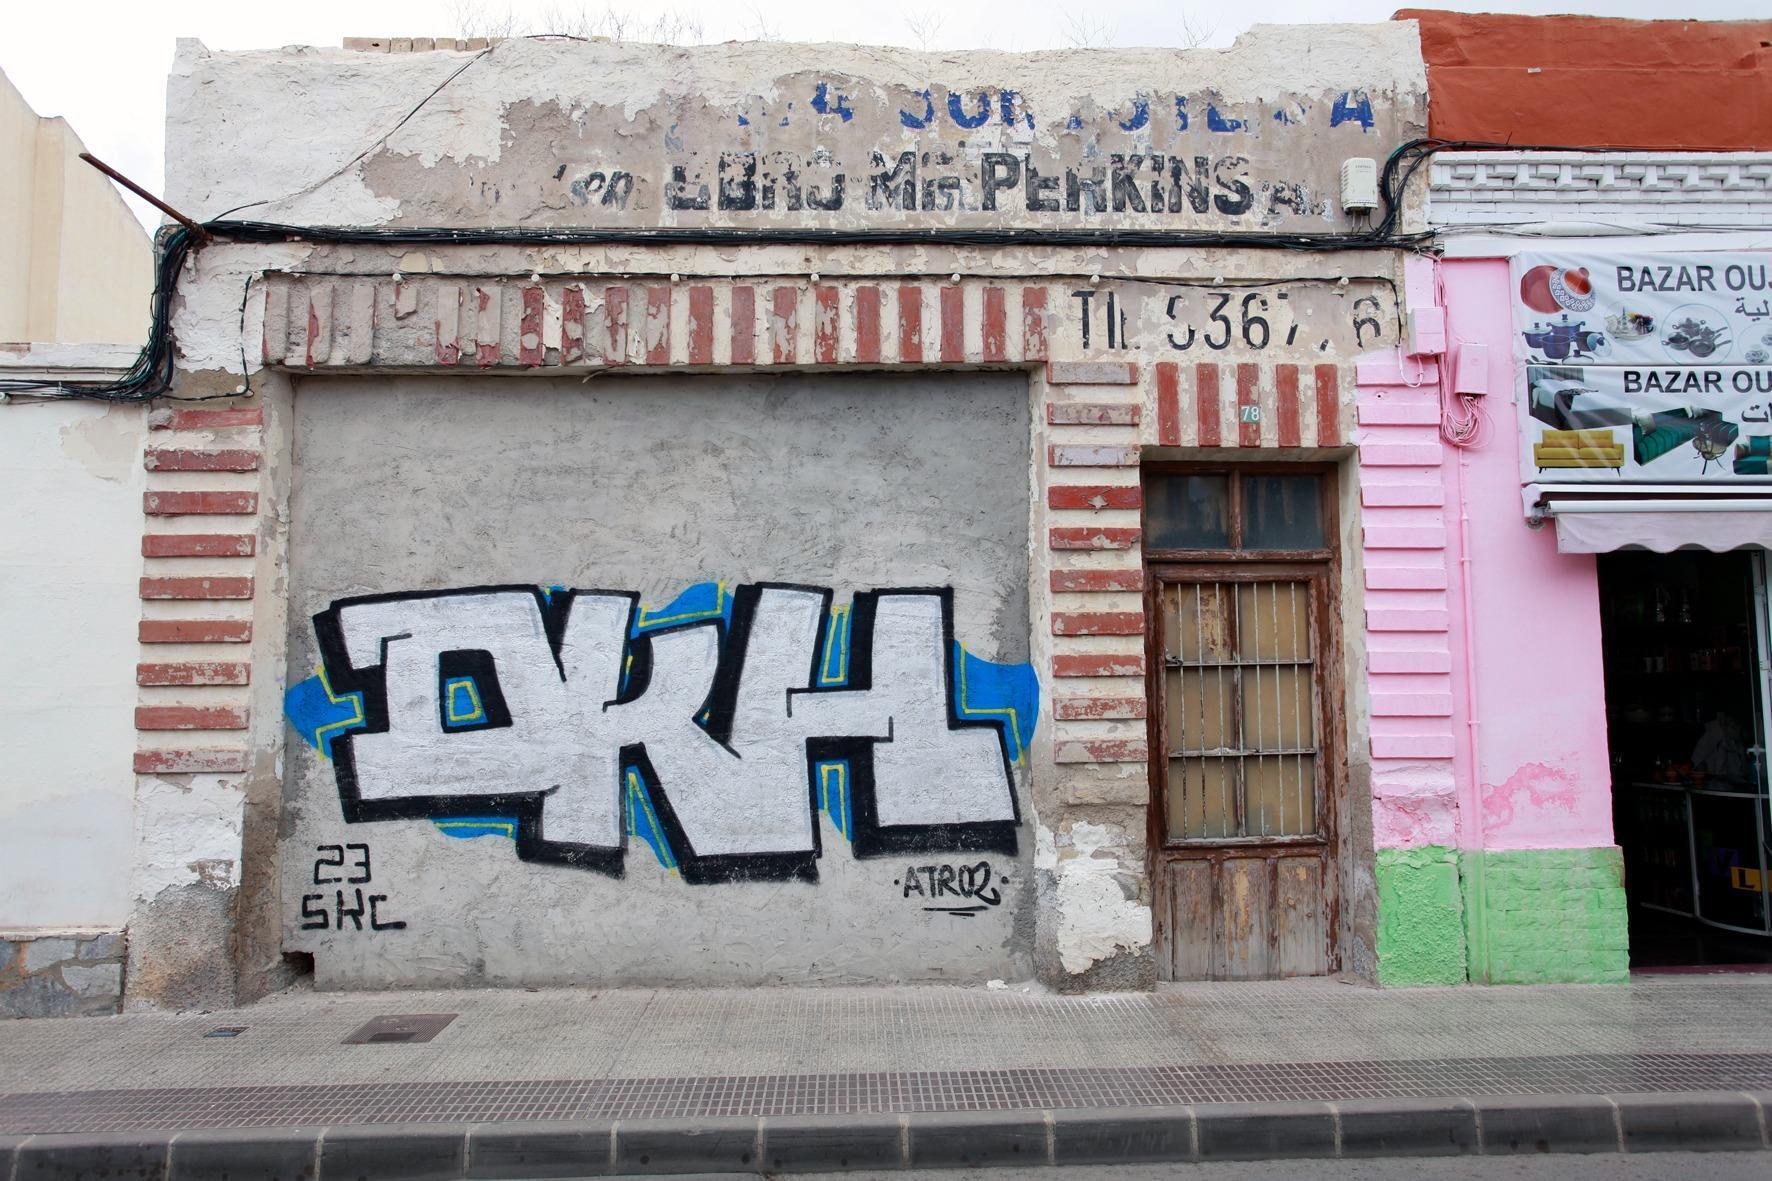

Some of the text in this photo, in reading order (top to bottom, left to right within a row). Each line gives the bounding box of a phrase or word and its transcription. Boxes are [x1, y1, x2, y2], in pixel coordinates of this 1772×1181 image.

[982, 153, 1253, 215] PERKINS
[1617, 266, 1716, 292] BAZAR
[1624, 370, 1723, 393] BAZAR
[1242, 406, 1260, 421] 78
[313, 843, 372, 885] 23
